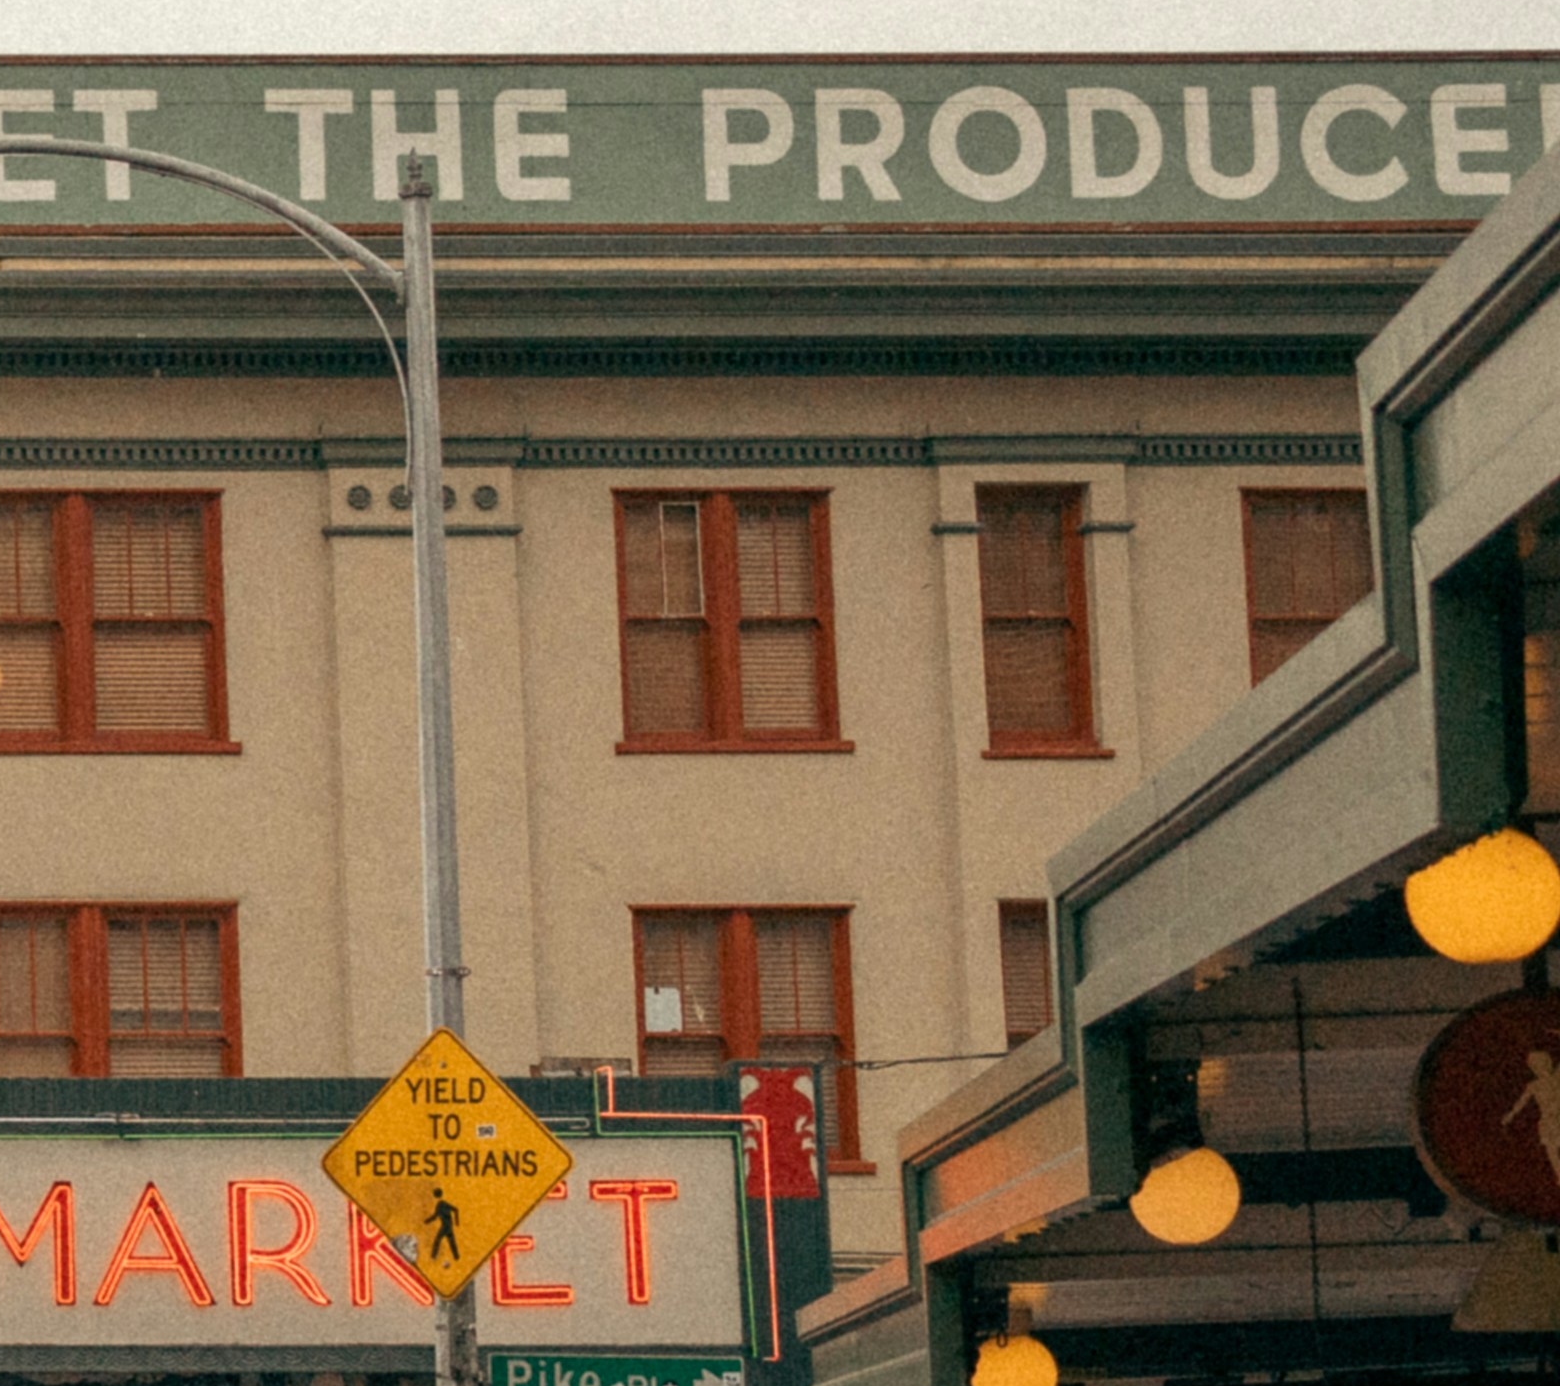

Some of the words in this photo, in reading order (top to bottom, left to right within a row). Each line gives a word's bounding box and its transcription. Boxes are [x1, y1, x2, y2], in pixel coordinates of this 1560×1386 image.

[262, 87, 573, 203] THE
[702, 83, 1560, 203] PRODUCE
[406, 1077, 486, 1105] YIELD
[427, 1114, 461, 1140] TO
[355, 1150, 538, 1178] PEDESTRIANS
